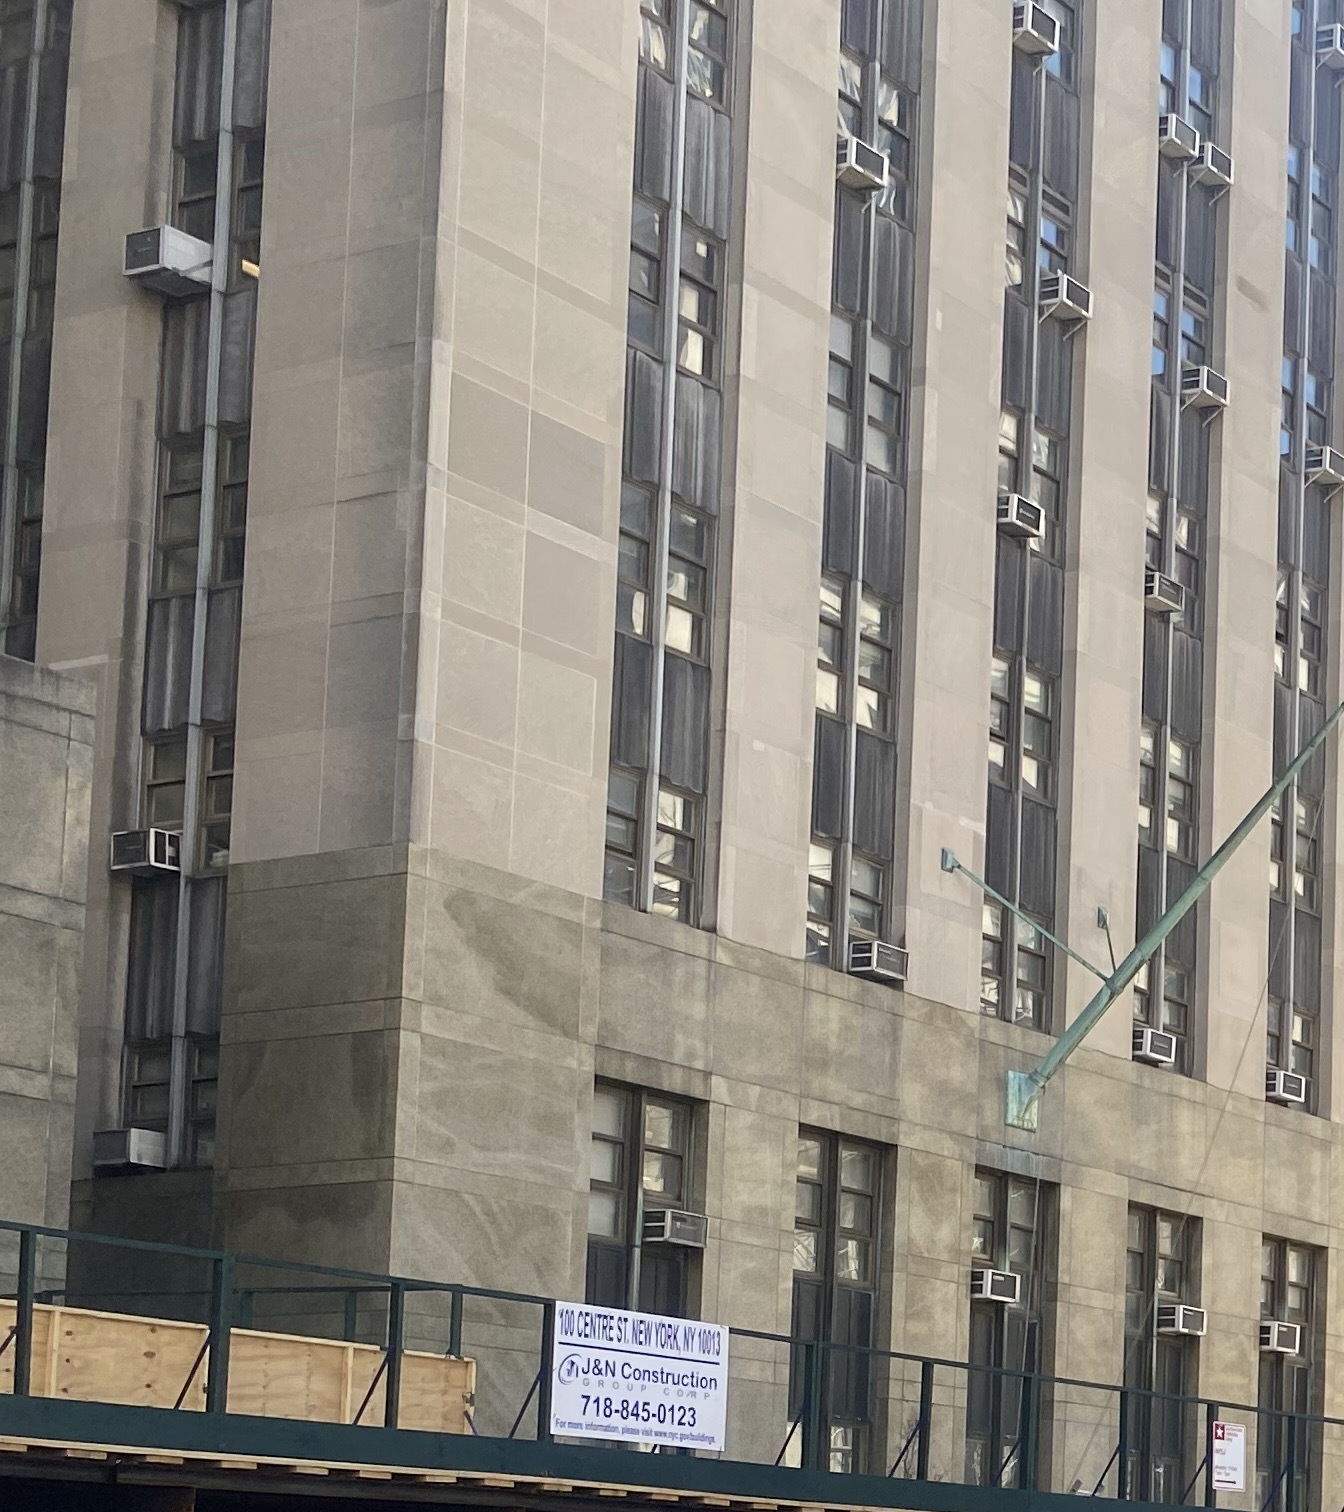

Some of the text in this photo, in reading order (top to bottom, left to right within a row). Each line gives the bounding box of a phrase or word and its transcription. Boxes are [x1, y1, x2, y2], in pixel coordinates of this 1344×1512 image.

[559, 1308, 575, 1337] 100
[577, 1310, 615, 1342] CENTRE
[631, 1318, 653, 1347] NEW
[683, 1326, 697, 1353] NY
[698, 1328, 721, 1356] 10013
[581, 1357, 718, 1391] J&N Construction
[582, 1377, 711, 1400] GROUP CORP
[581, 1394, 697, 1428] 718-845-0123
